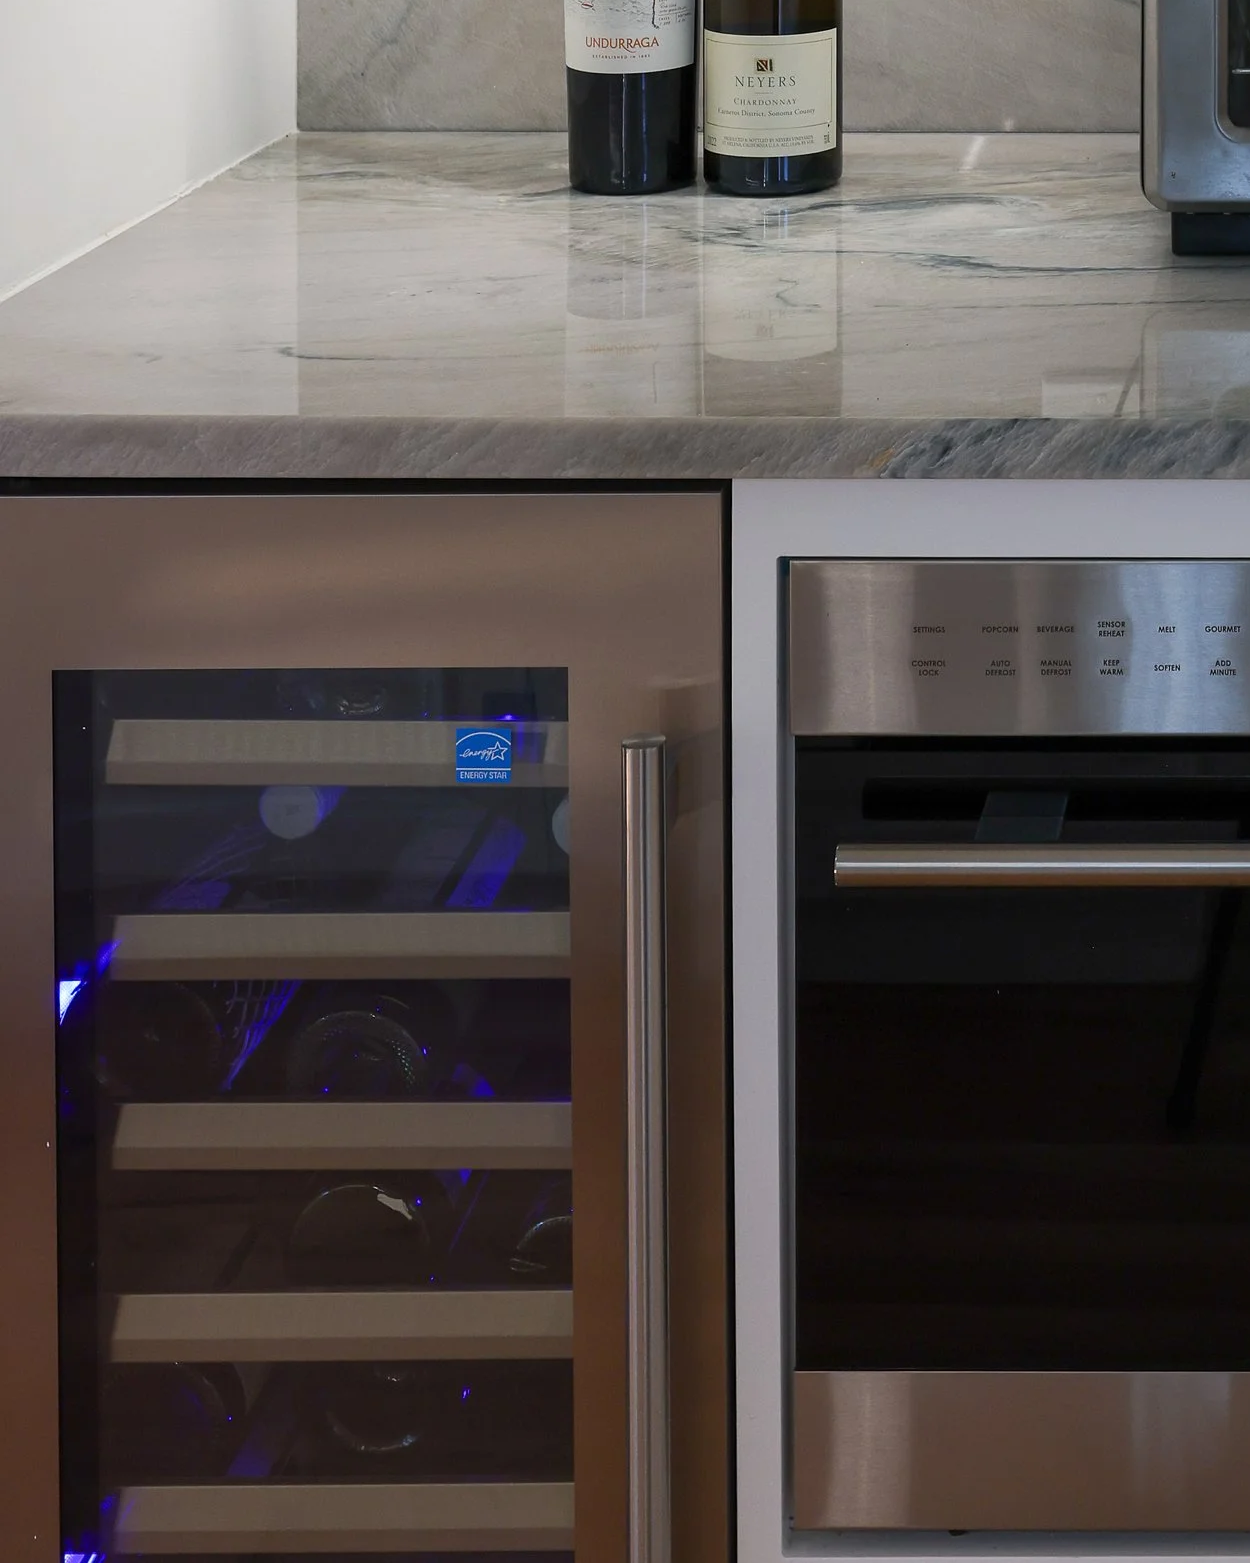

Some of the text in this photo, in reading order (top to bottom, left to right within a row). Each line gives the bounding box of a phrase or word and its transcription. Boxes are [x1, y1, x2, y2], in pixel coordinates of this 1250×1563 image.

[585, 36, 659, 53] UNDURRAGA
[735, 76, 796, 87] NEYERS
[911, 660, 946, 668] CONTROL
[1154, 664, 1180, 672] SOFTEN
[1100, 668, 1124, 676] WARM
[460, 771, 507, 779] ENERGY STAR
